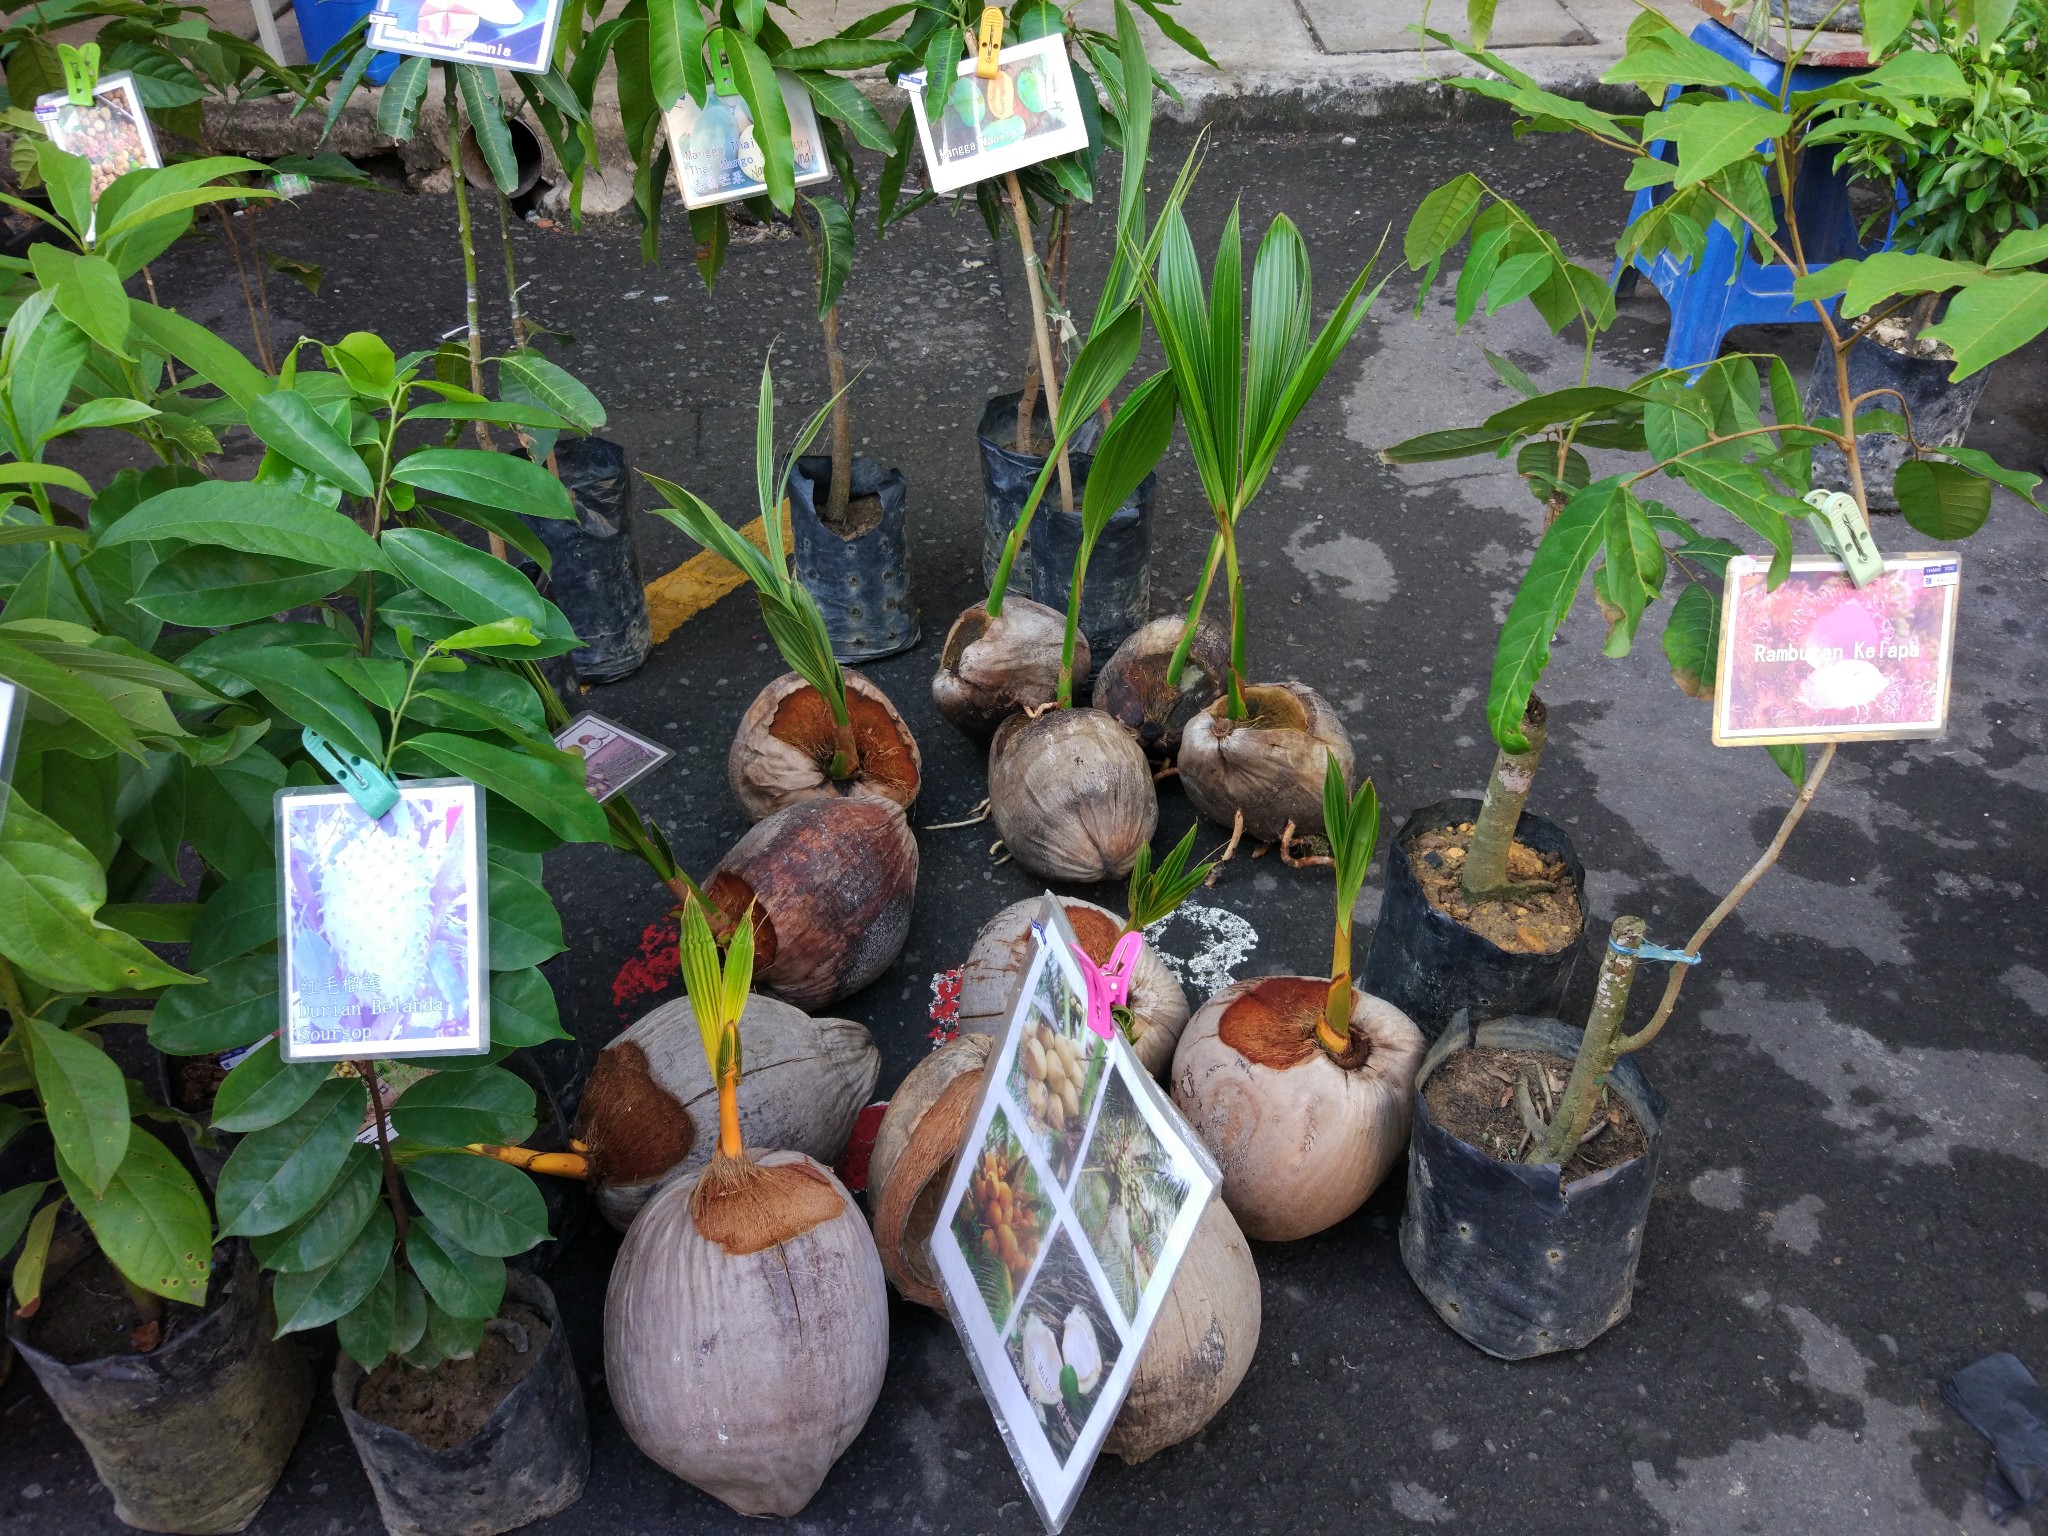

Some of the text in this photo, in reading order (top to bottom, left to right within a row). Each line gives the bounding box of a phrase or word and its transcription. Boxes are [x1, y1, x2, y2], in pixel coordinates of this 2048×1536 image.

[684, 137, 755, 161] Mangga Thai
[938, 143, 976, 159] Mangga
[689, 156, 754, 176] Thai Mango
[1854, 640, 1920, 661] Kelapa
[299, 996, 444, 1019] Durian Belanda
[299, 1025, 372, 1043] Soursop
